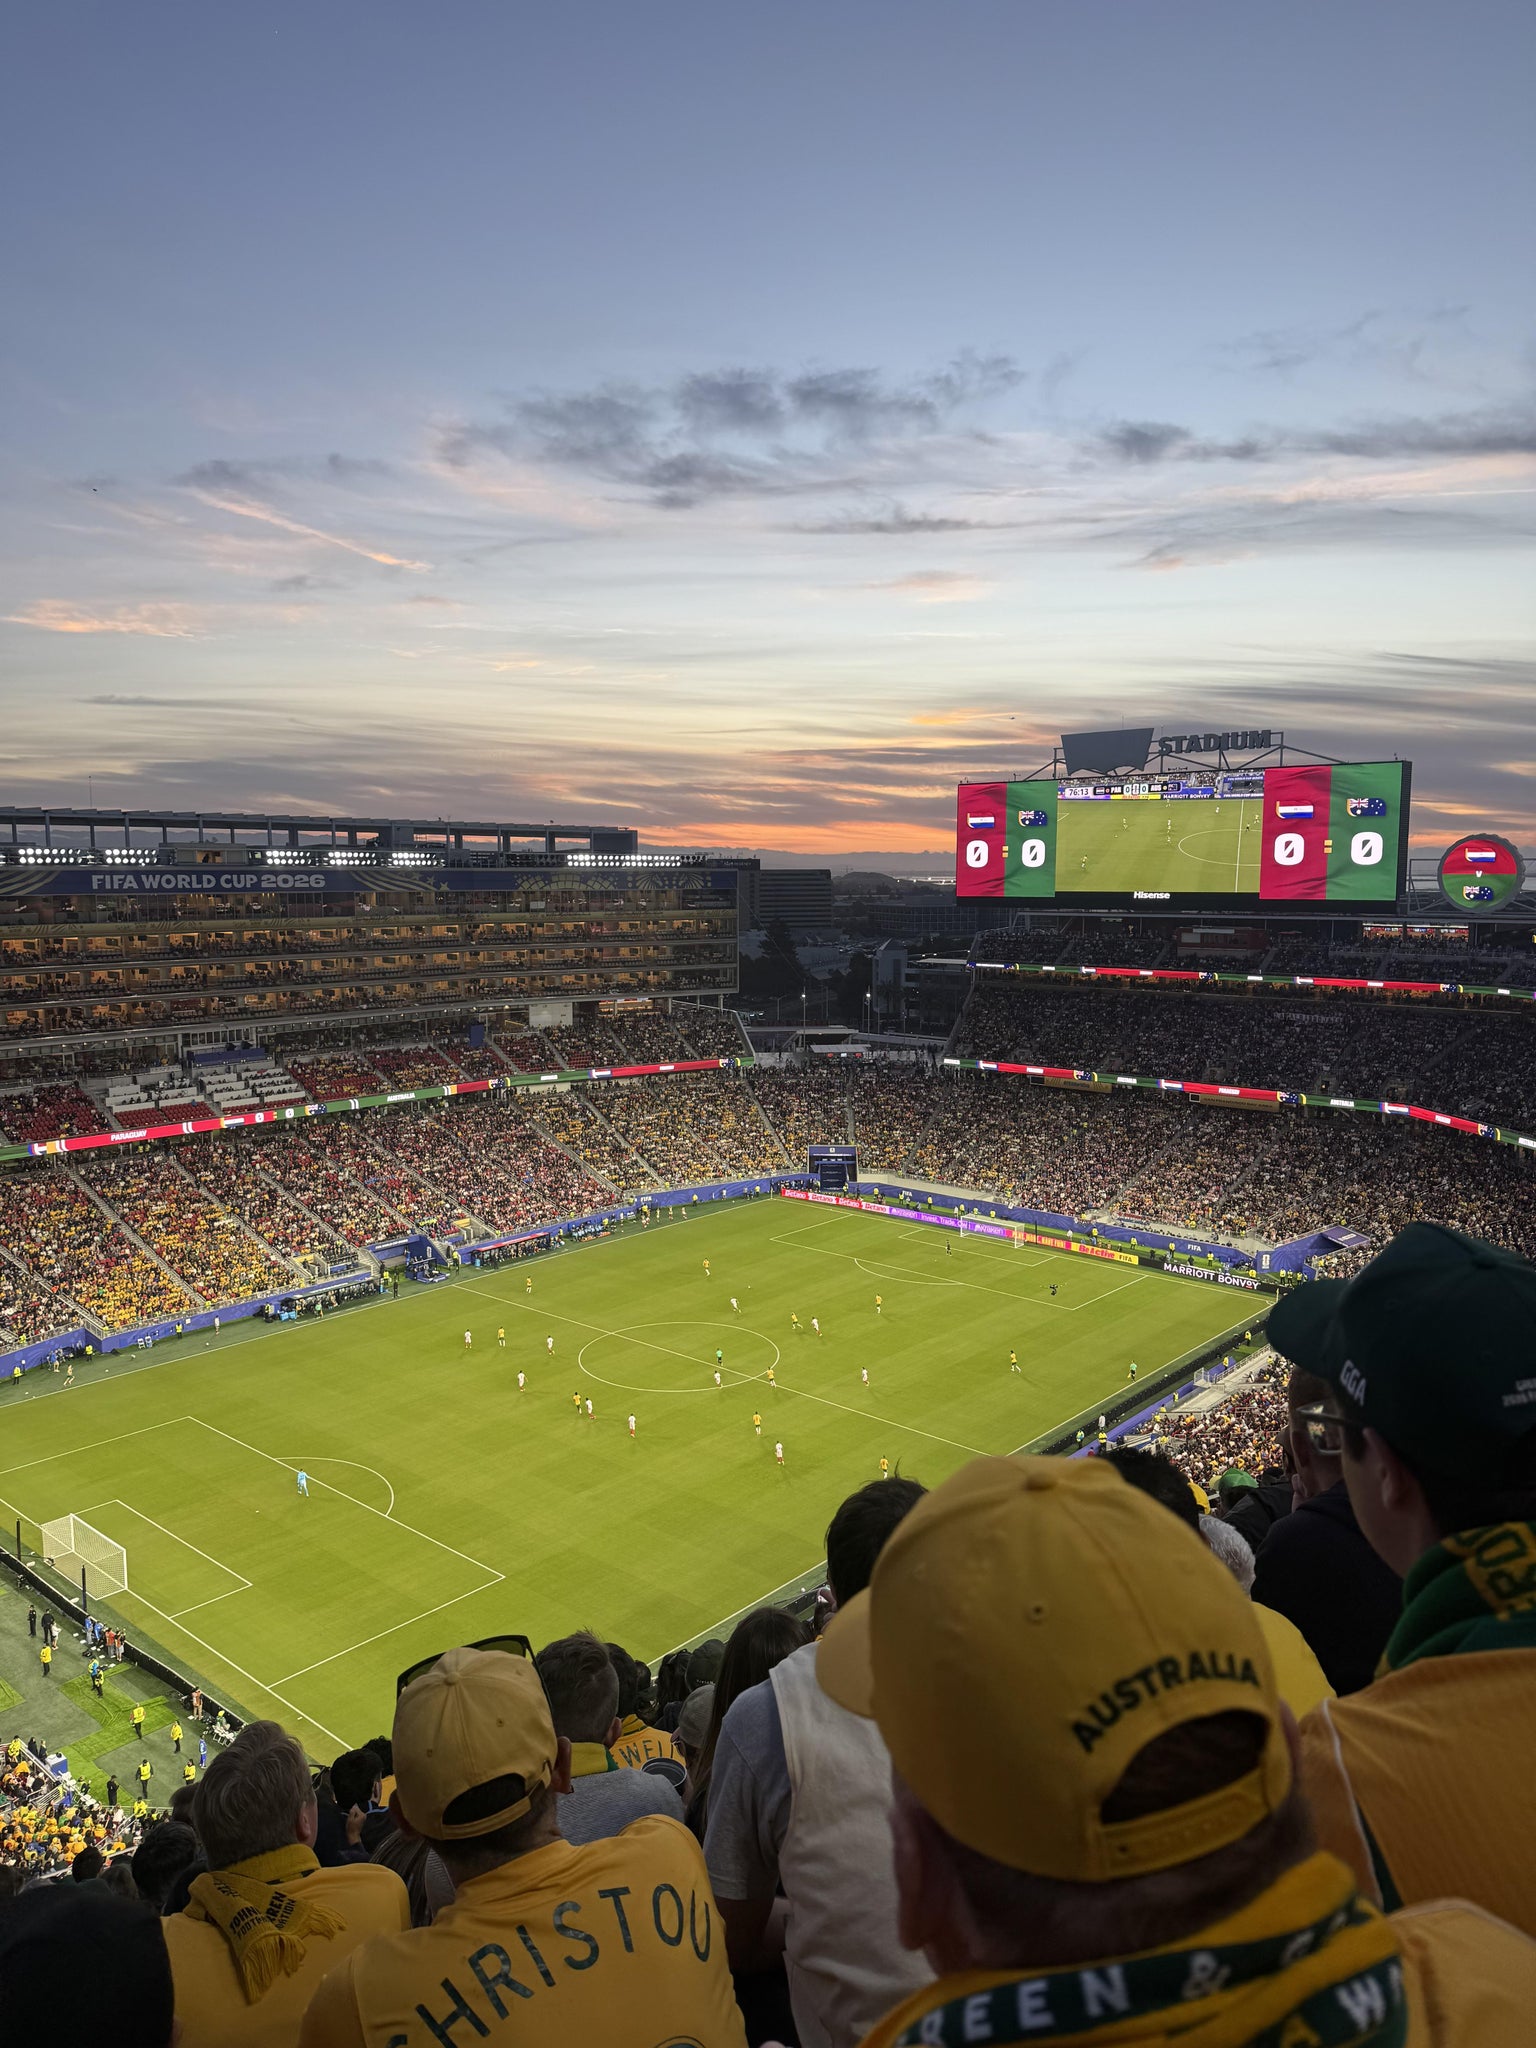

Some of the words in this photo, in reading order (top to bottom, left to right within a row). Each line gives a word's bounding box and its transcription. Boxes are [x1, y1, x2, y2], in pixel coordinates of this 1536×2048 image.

[1158, 730, 1272, 755] STADIUM
[1110, 786, 1121, 794] PAR
[966, 840, 989, 868] 0
[1021, 838, 1046, 867] 0
[1274, 833, 1305, 866] 0
[1350, 831, 1384, 865] 0
[91, 874, 139, 889] FIFA
[141, 874, 216, 889] WORLD
[220, 874, 258, 888] CUP
[261, 874, 326, 888] 2026
[1133, 890, 1171, 900] Hisense
[386, 1092, 416, 1102] AUSTRALIA
[110, 1129, 147, 1142] PARAGUAY
[785, 1190, 807, 1200] Betano
[811, 1194, 834, 1204] Betano
[838, 1198, 860, 1208] Betano
[865, 1202, 887, 1213] Betano
[1187, 1243, 1202, 1252] FIFA
[1118, 1252, 1133, 1263] FIFA
[1163, 1262, 1217, 1281] MARRIOTT
[1217, 1273, 1259, 1290] BONVOY
[1070, 1650, 1262, 1754] AUSTRALIA
